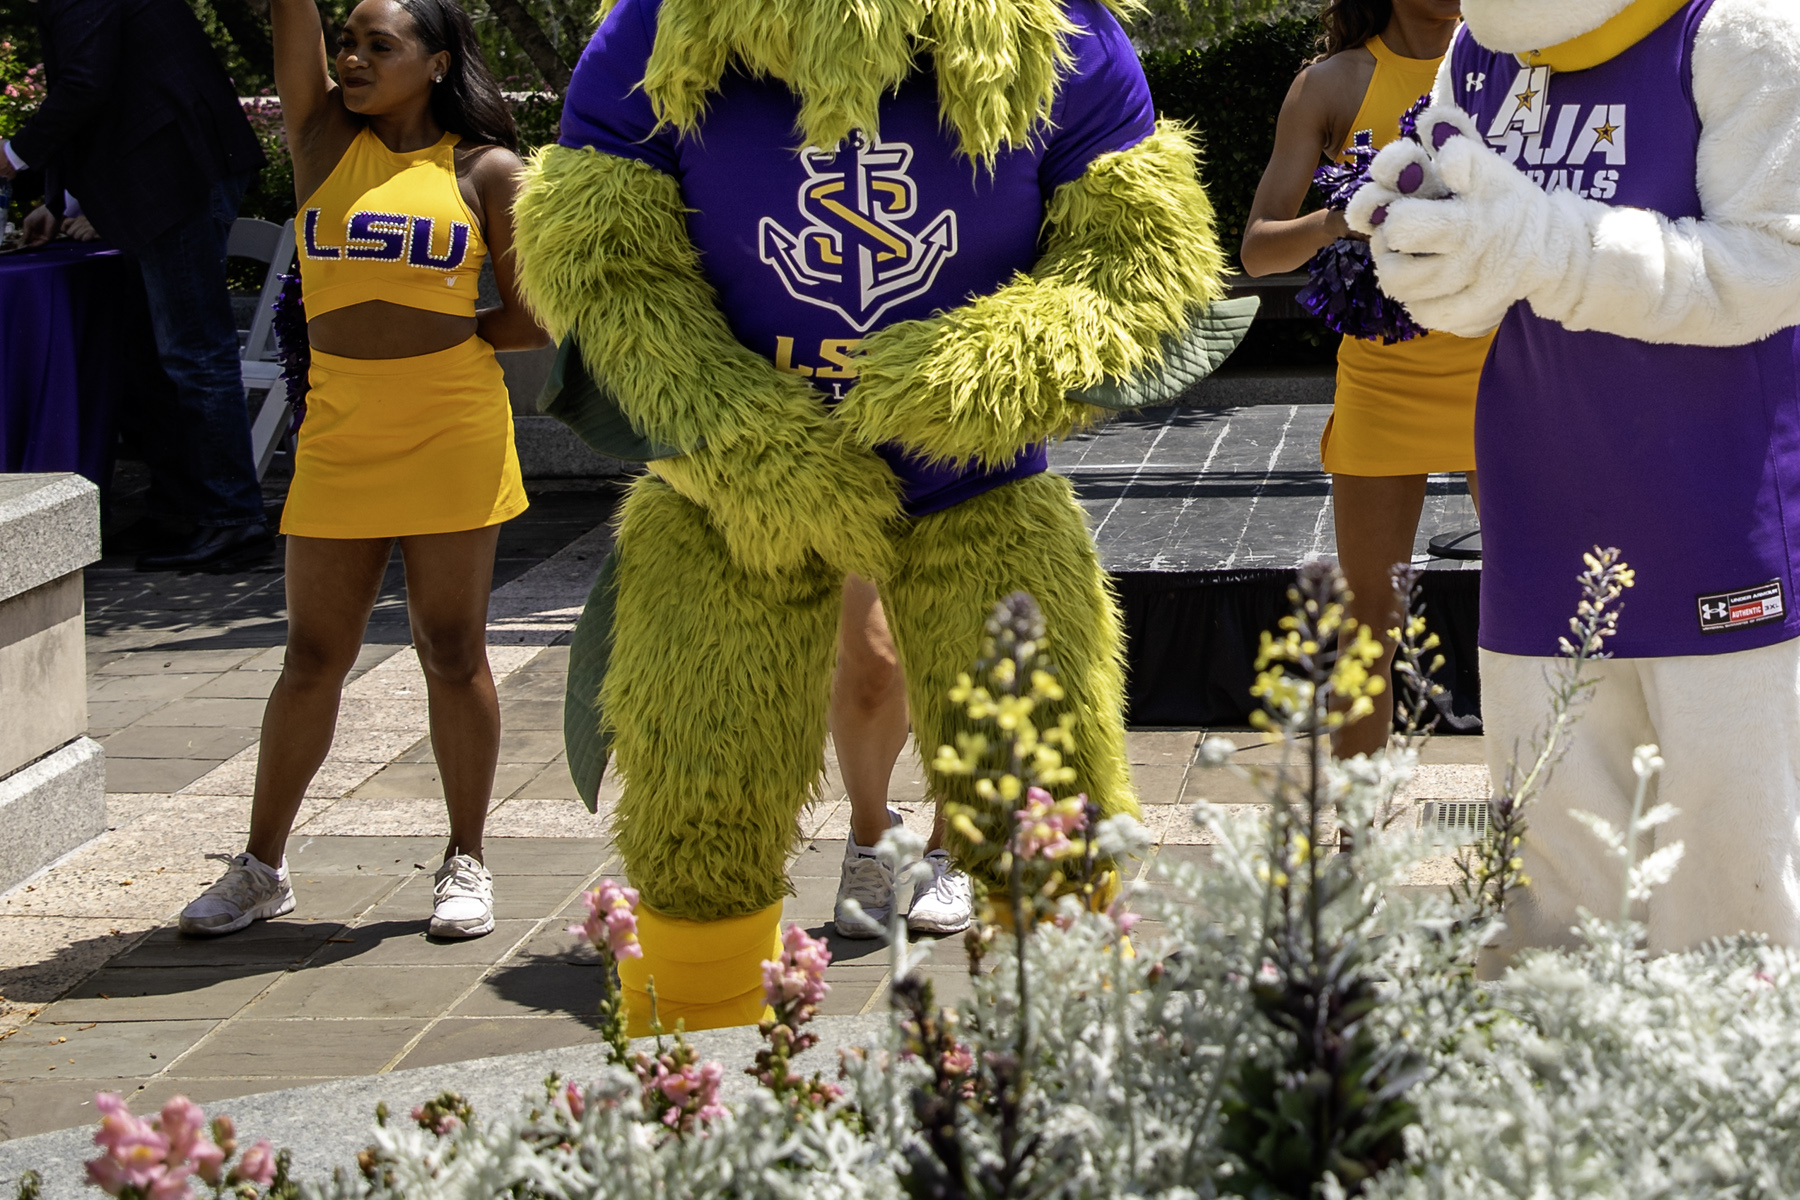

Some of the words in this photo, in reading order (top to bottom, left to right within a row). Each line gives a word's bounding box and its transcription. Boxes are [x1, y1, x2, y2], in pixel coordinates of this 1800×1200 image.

[304, 208, 471, 271] LSU
[775, 335, 862, 379] LS
[1730, 594, 1752, 603] UNDER
[1752, 588, 1778, 599] ARMOUR
[1731, 606, 1762, 618] AUTHENTIC
[1764, 603, 1779, 611] 3XL
